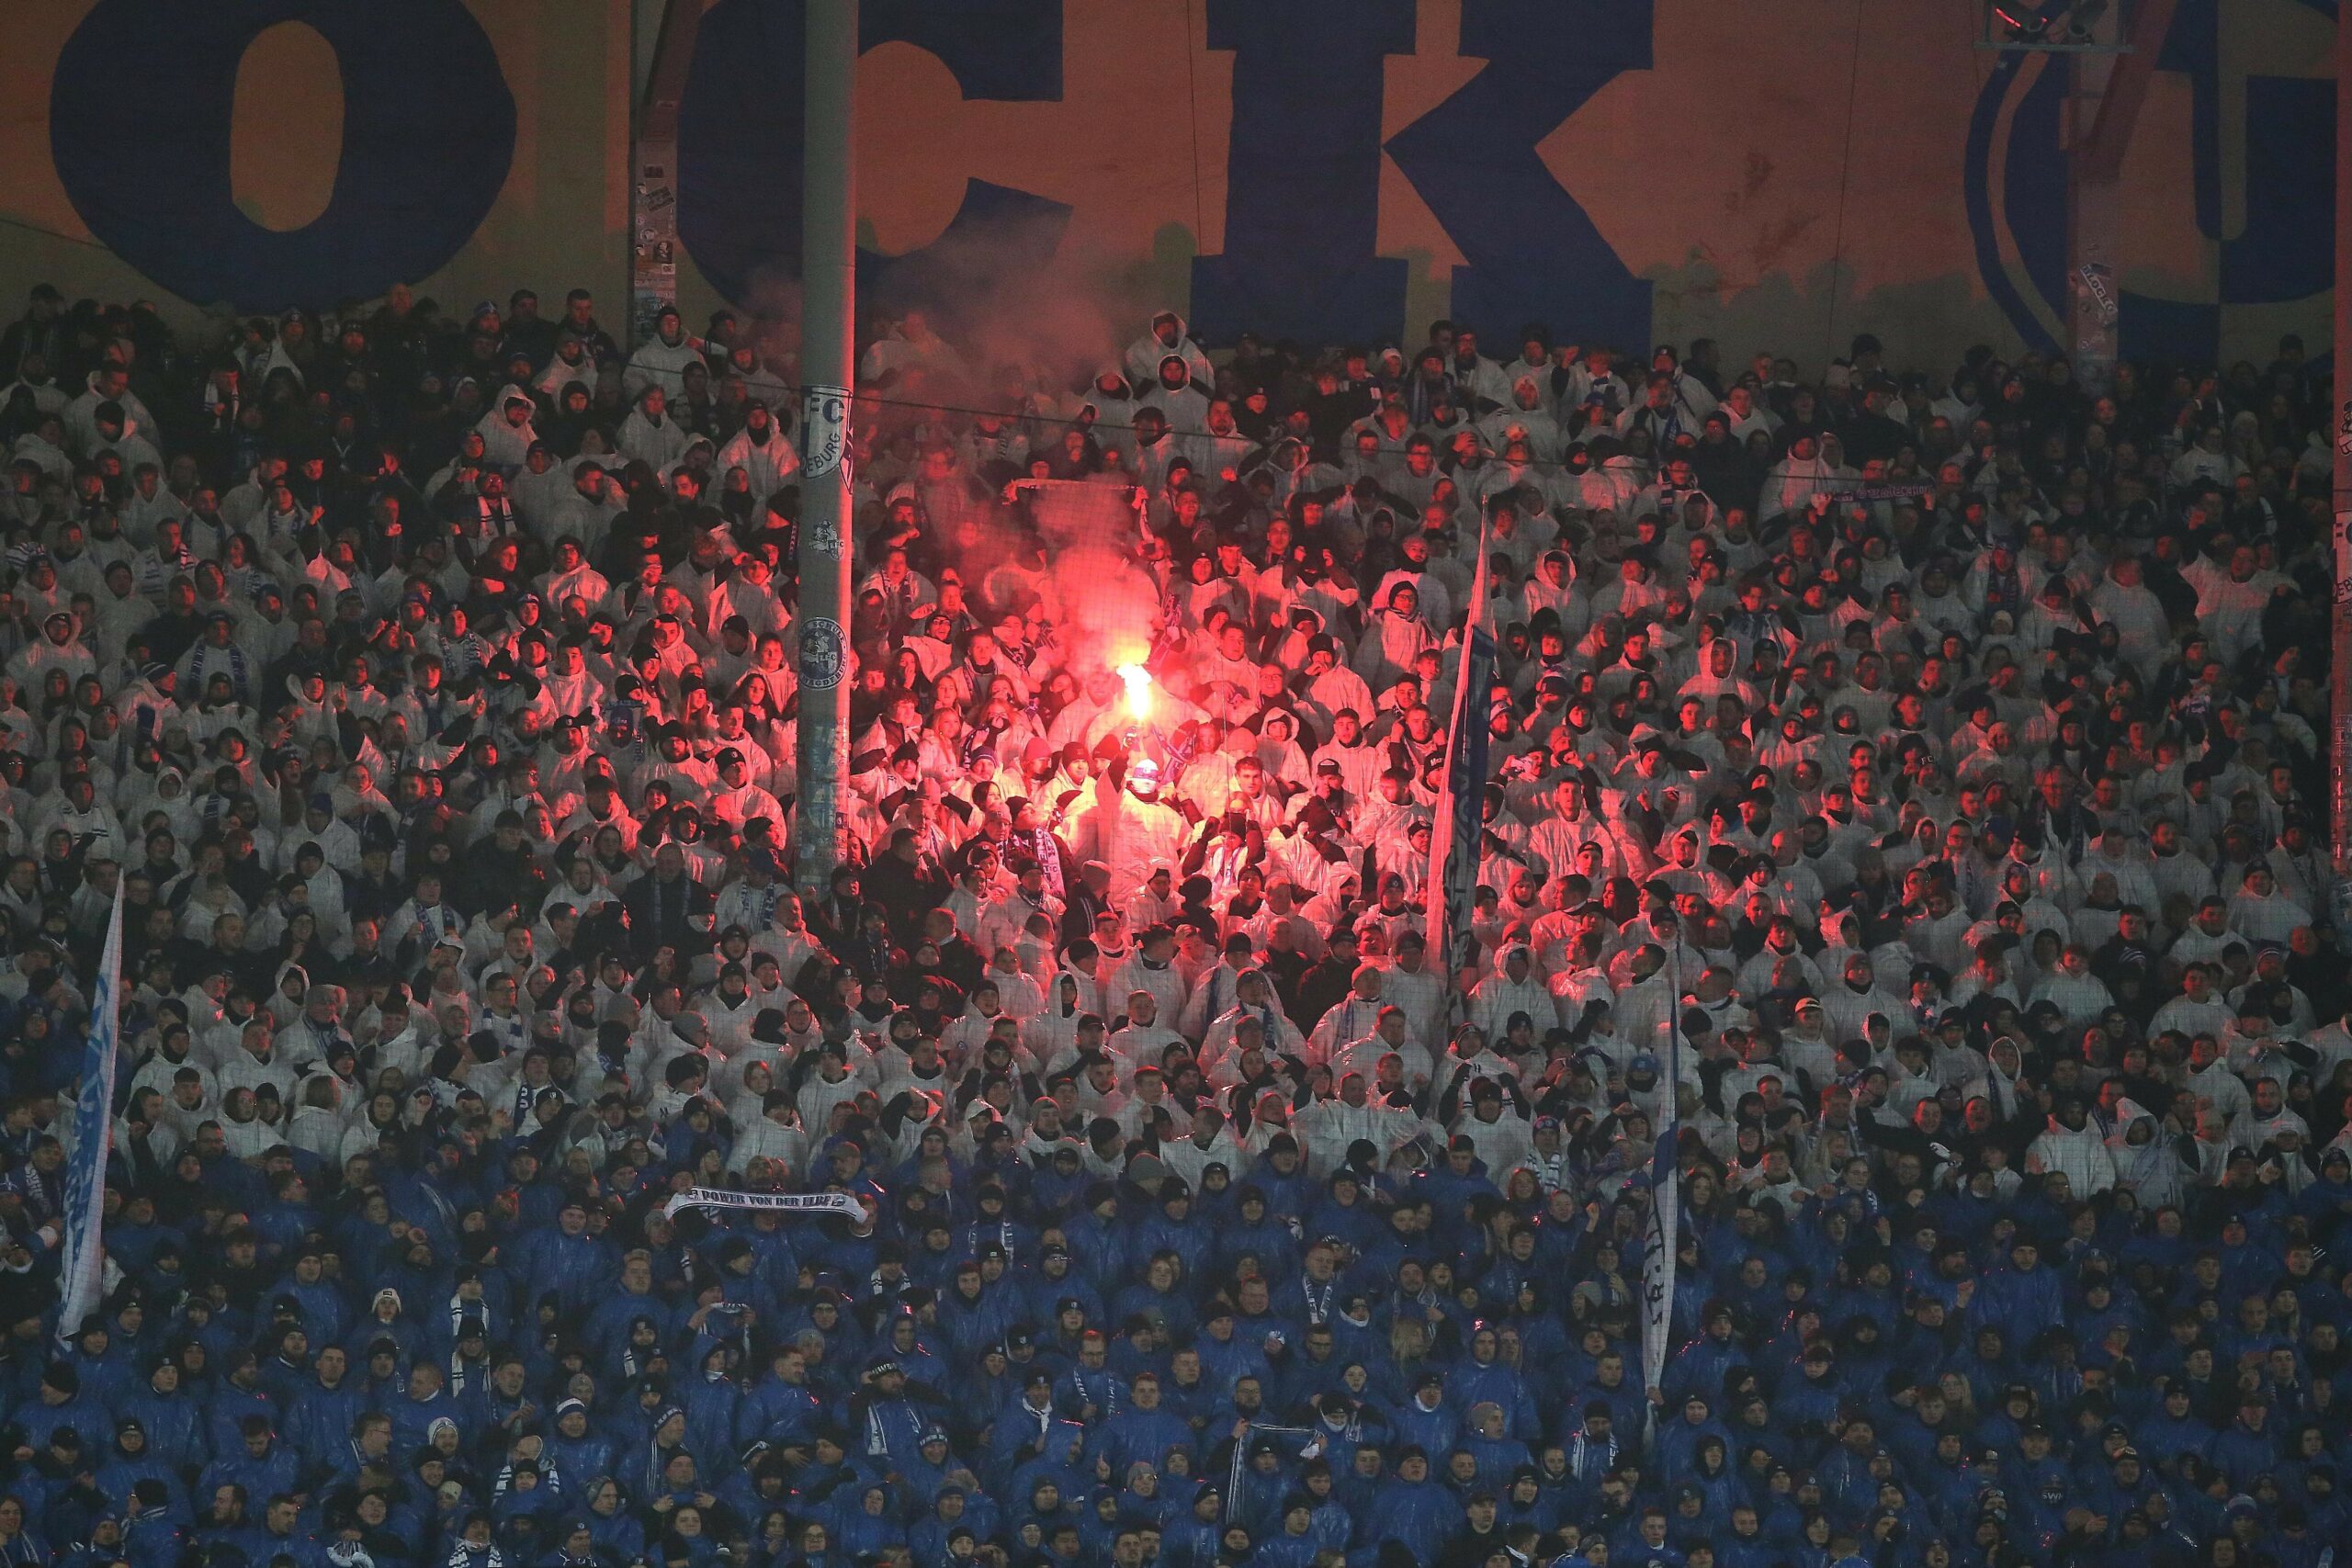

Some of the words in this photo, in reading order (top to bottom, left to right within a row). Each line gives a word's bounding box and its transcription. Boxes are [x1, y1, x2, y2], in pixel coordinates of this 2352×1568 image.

[701, 1190, 745, 1204] POWER
[749, 1195, 773, 1206] VON
[775, 1197, 800, 1207] DER
